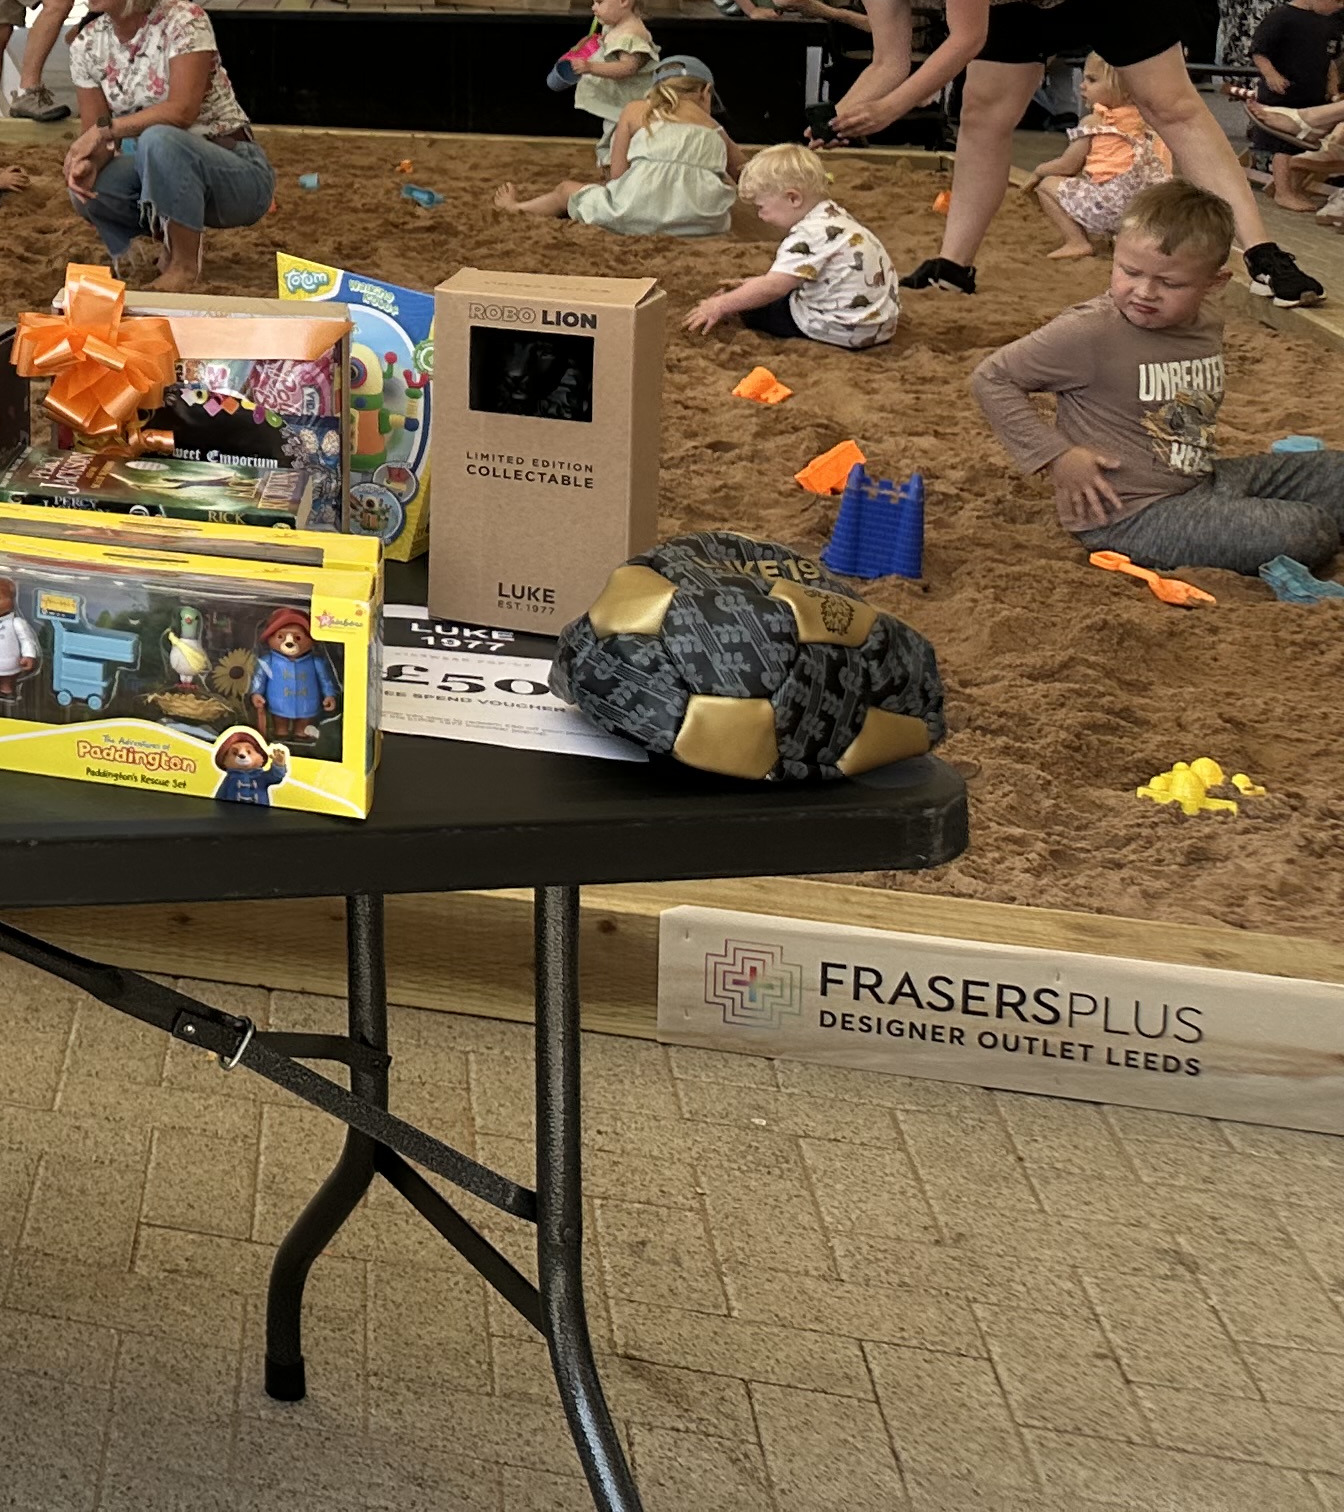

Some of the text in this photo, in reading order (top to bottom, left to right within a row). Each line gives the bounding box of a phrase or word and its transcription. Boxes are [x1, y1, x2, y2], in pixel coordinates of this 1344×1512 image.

[468, 302, 598, 330] ROBO LION
[206, 449, 278, 468] Emporium
[466, 451, 594, 473] LIMITED EDITION
[466, 464, 594, 489] COLLECTABLE
[53, 496, 98, 508] PERCY
[208, 511, 246, 524] RICK
[498, 582, 555, 604] LUKE
[411, 622, 515, 641] LUKE
[421, 636, 506, 652] 1977
[382, 664, 550, 696] £50
[412, 693, 472, 703] SPEND
[477, 699, 566, 713] VOUCHER
[102, 734, 115, 744] The
[119, 737, 160, 750] Adventures
[77, 740, 196, 773] Paddington
[86, 767, 187, 789] Paddington's Rescue Set
[820, 961, 1204, 1044] FRASERSPLUS
[820, 1009, 1203, 1077] DESIGNER OUTLET LEEDS
